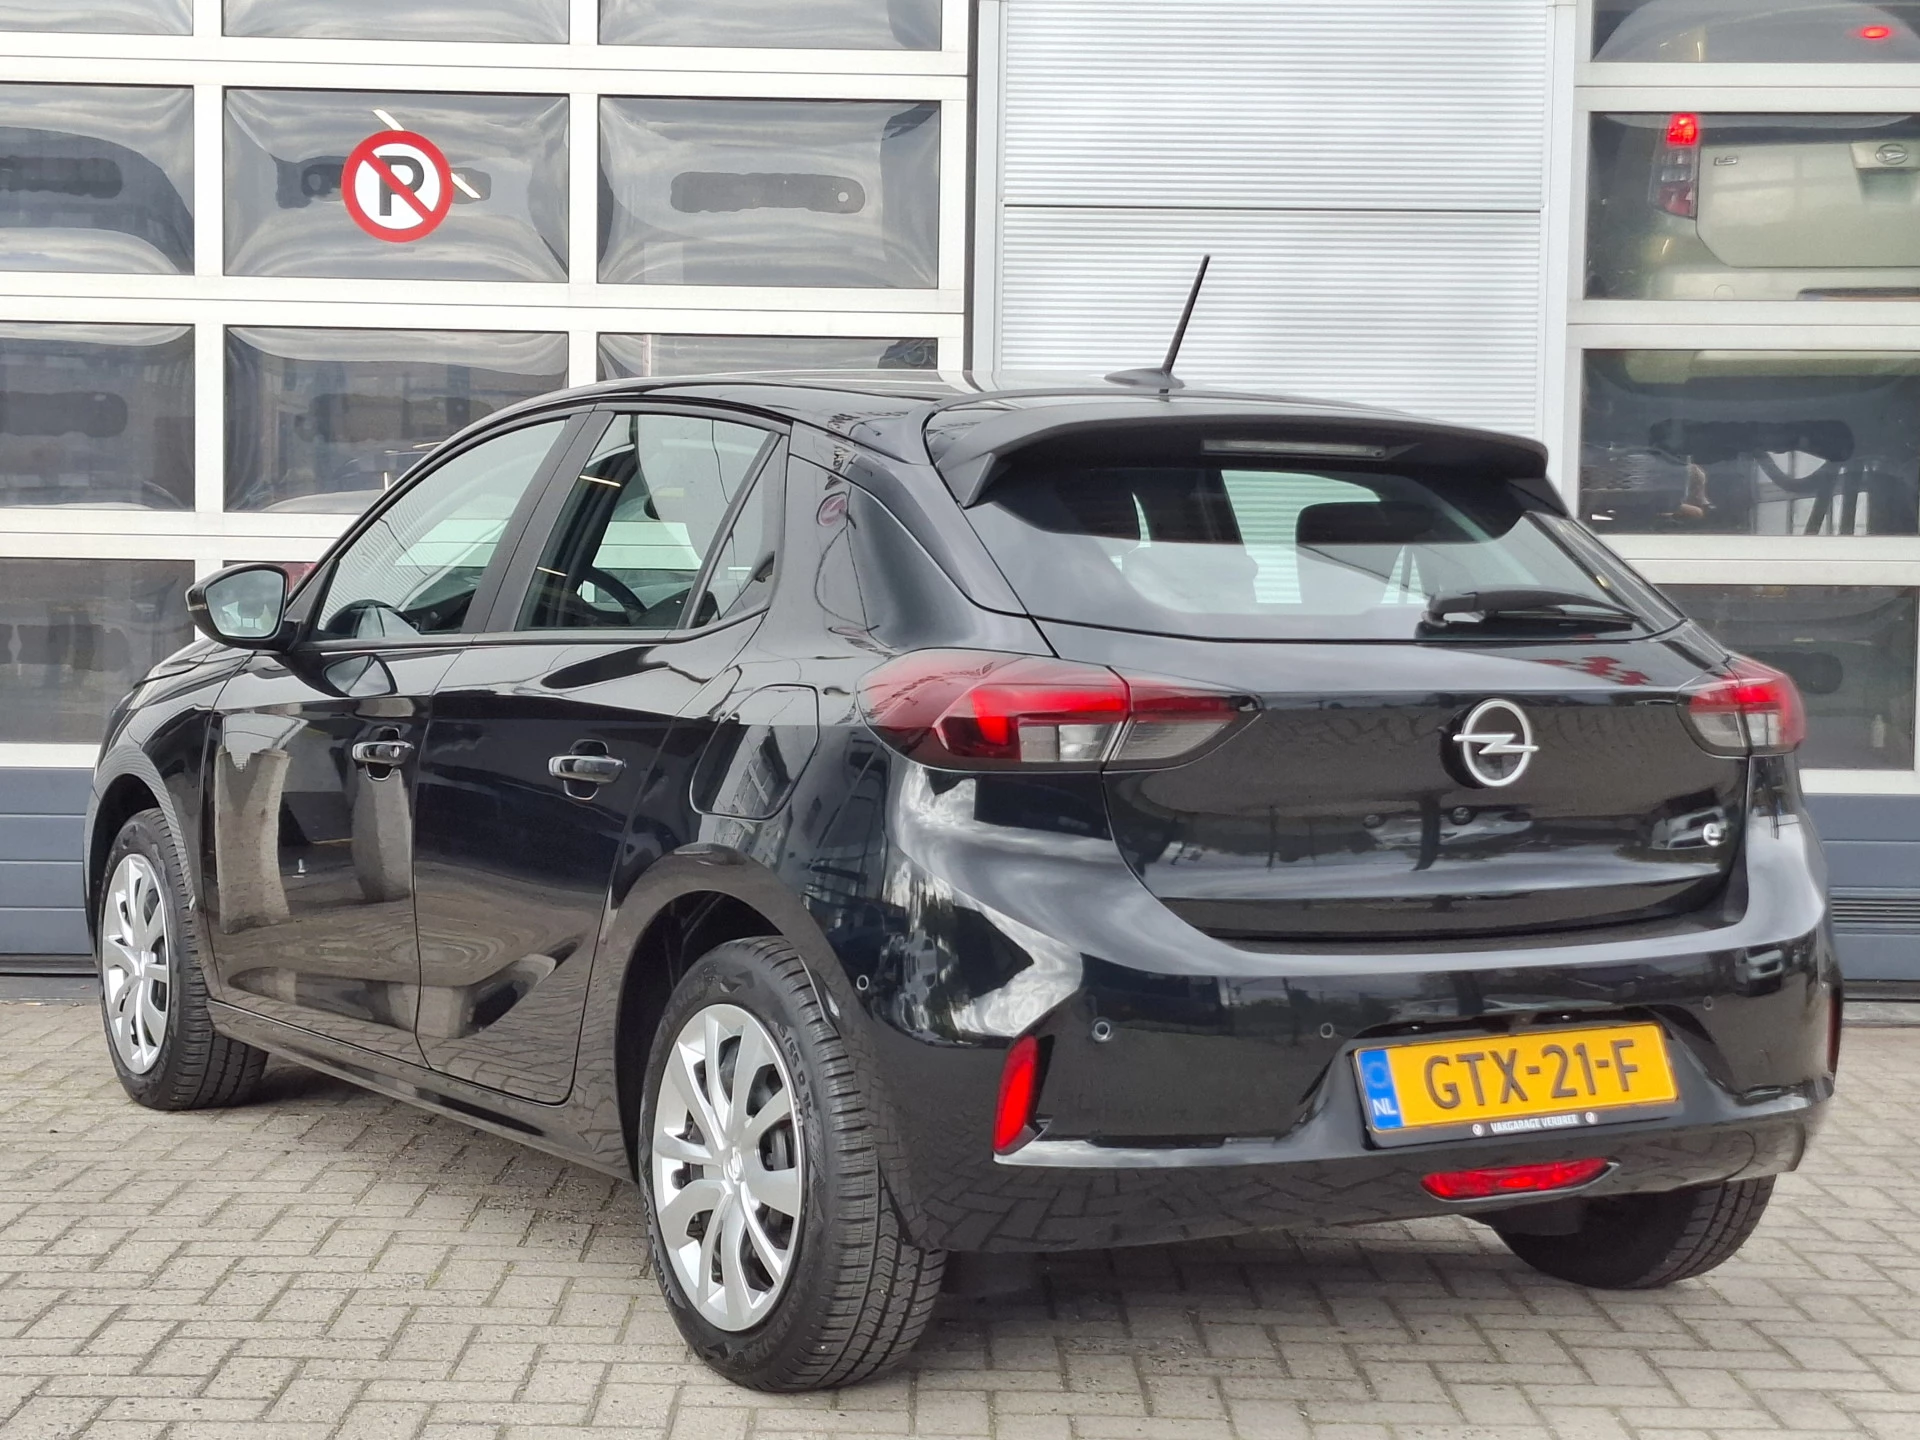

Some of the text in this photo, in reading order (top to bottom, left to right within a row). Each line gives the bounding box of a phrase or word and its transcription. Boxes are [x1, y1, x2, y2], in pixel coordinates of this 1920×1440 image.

[1424, 1039, 1638, 1109] GTX-21-F
[1373, 1098, 1397, 1116] NL
[1490, 1118, 1542, 1132] VAKGARAGE
